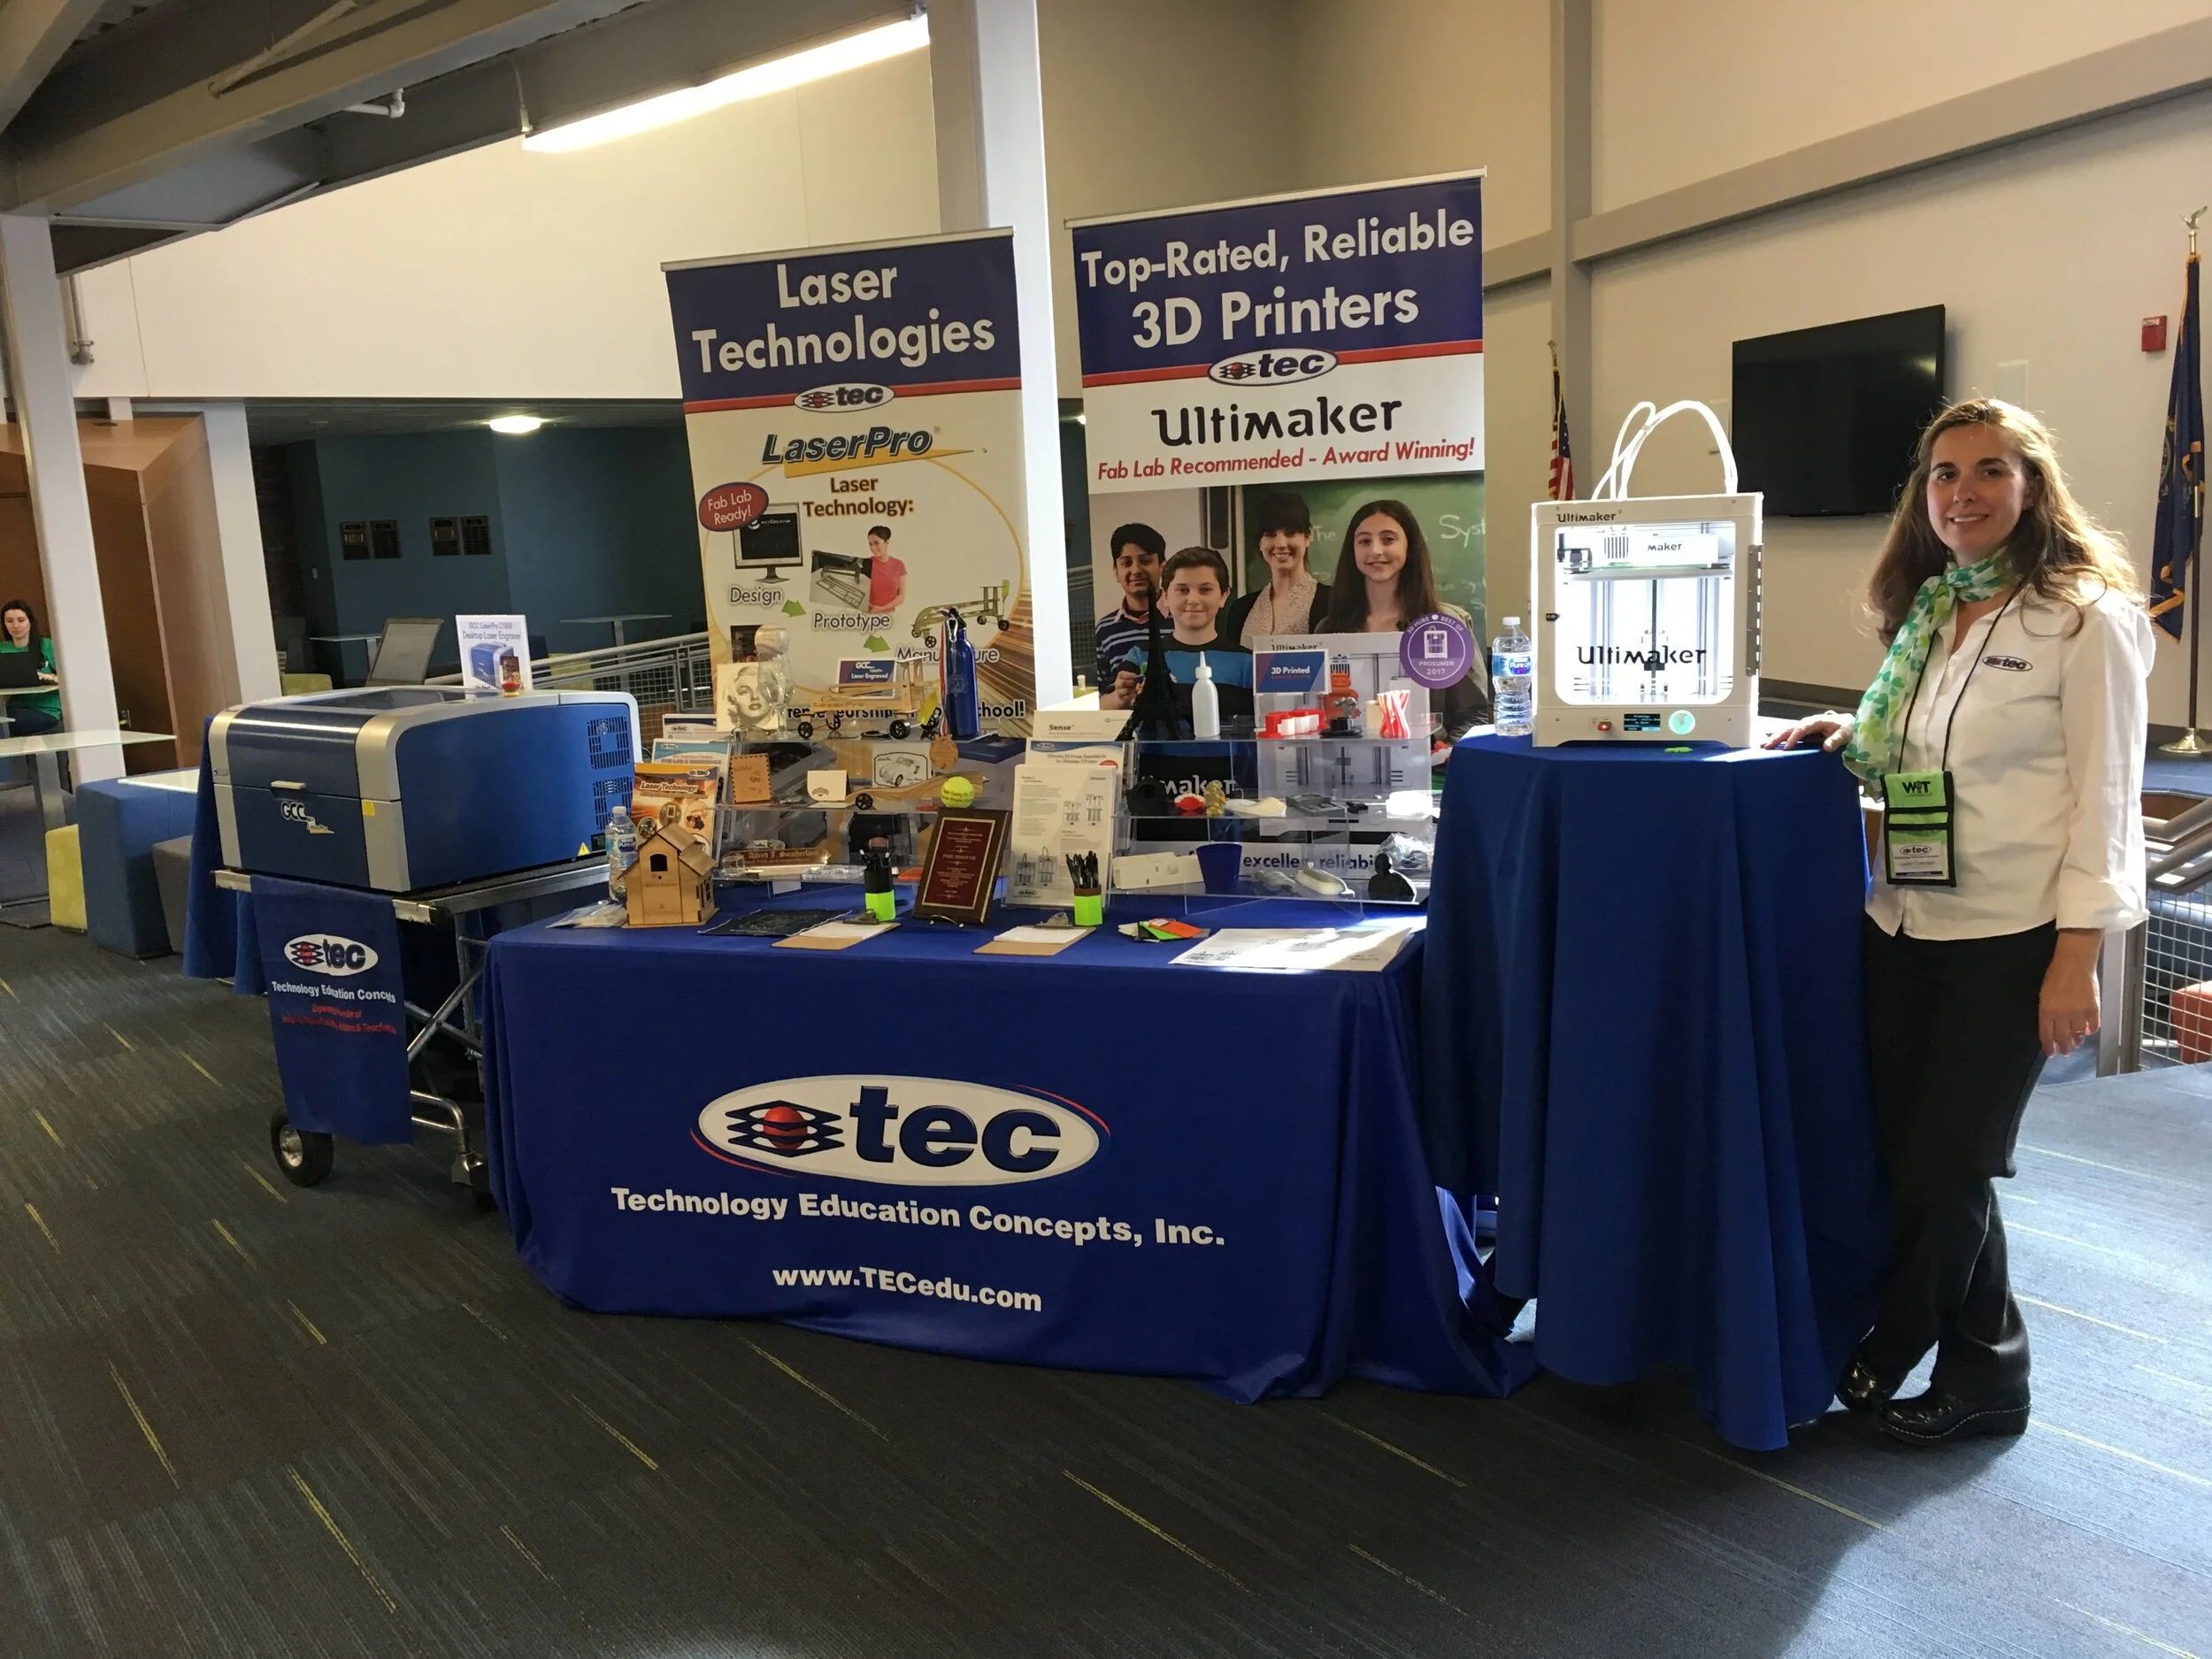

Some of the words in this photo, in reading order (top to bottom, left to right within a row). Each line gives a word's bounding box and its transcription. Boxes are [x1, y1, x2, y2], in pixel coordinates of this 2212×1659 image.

[1081, 229, 1288, 291] Top-Rated,
[1304, 208, 1474, 263] Reliable
[777, 264, 898, 307] Laser
[1133, 296, 1202, 349] 3D
[1222, 287, 1418, 340] Printers
[692, 308, 995, 373] Technologies
[1259, 354, 1325, 378] tec
[836, 385, 883, 406] tec
[1152, 396, 1402, 446] Ultimaker
[762, 426, 932, 464] LaserPro
[1099, 461, 1129, 480] Fab
[1133, 459, 1165, 478] Lab
[1171, 451, 1303, 475] Recommended
[1323, 443, 1388, 465] Award
[1395, 437, 1474, 461] Winning!
[831, 477, 878, 494] Laser
[708, 494, 728, 511] Fab
[731, 490, 752, 509] Lab
[803, 496, 914, 518] Technology:
[714, 504, 752, 526] Ready!
[1556, 511, 1616, 523] Ultimaker
[730, 587, 782, 605] Design
[814, 612, 890, 632] Prototype
[897, 646, 999, 664] Manuure
[1578, 645, 1706, 664] Ultimaker
[2002, 657, 2026, 670] tec
[1283, 665, 1310, 674] Printed
[978, 700, 1025, 718] chool!
[281, 801, 307, 821] GCC
[1243, 853, 1301, 867] excelle
[323, 939, 365, 970] tec
[271, 981, 319, 997] Technology
[849, 1085, 1062, 1172] tec
[611, 1187, 788, 1221] Technology
[799, 1192, 962, 1228] Education
[969, 1205, 1143, 1247] Concepts,
[1155, 1217, 1225, 1246] Inc.
[772, 1265, 1042, 1312] www.TECedu.com
